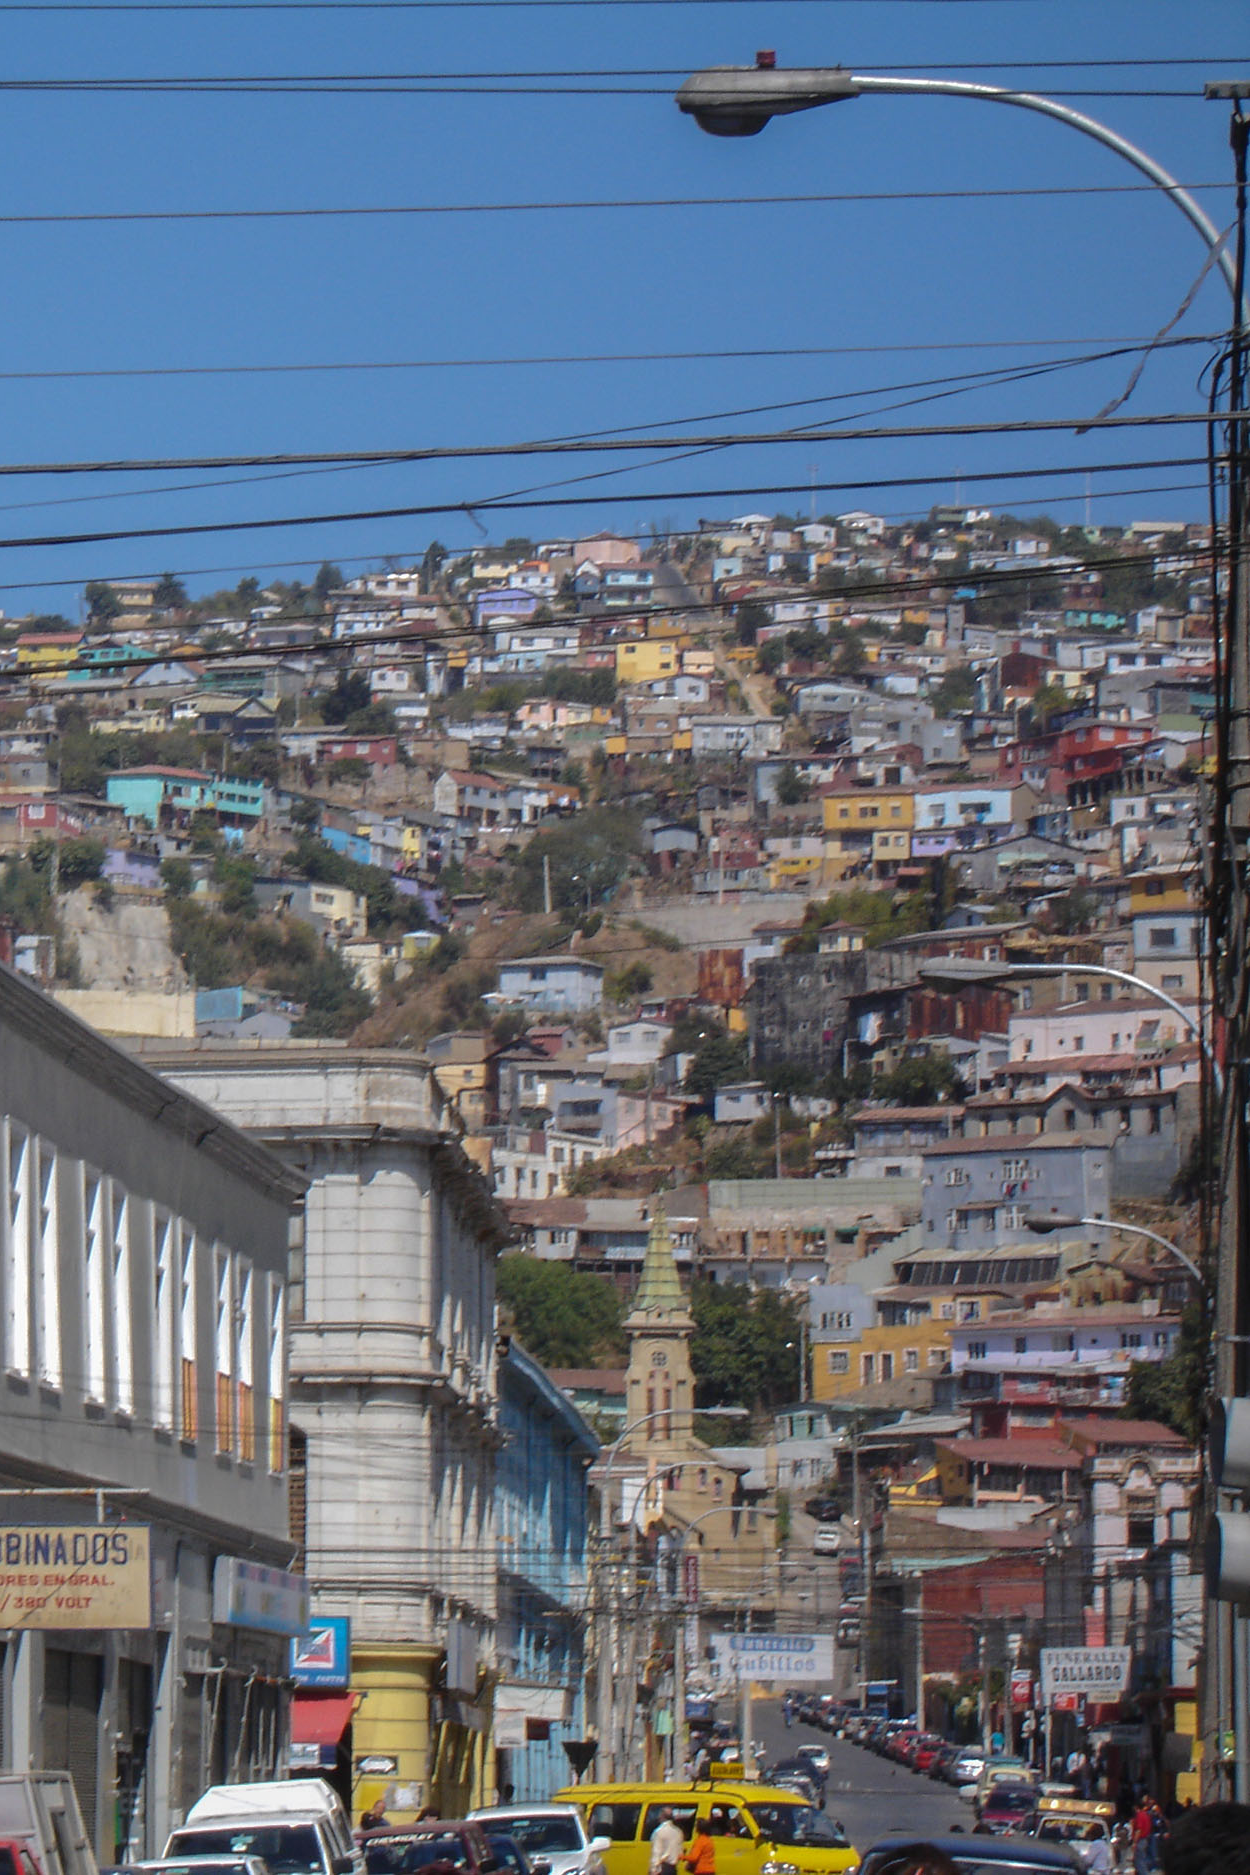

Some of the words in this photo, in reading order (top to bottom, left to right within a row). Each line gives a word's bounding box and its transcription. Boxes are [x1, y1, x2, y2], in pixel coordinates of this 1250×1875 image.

[44, 1574, 65, 1586] EN
[55, 1596, 93, 1609] VOLT
[1052, 1665, 1122, 1683] GALLARDO
